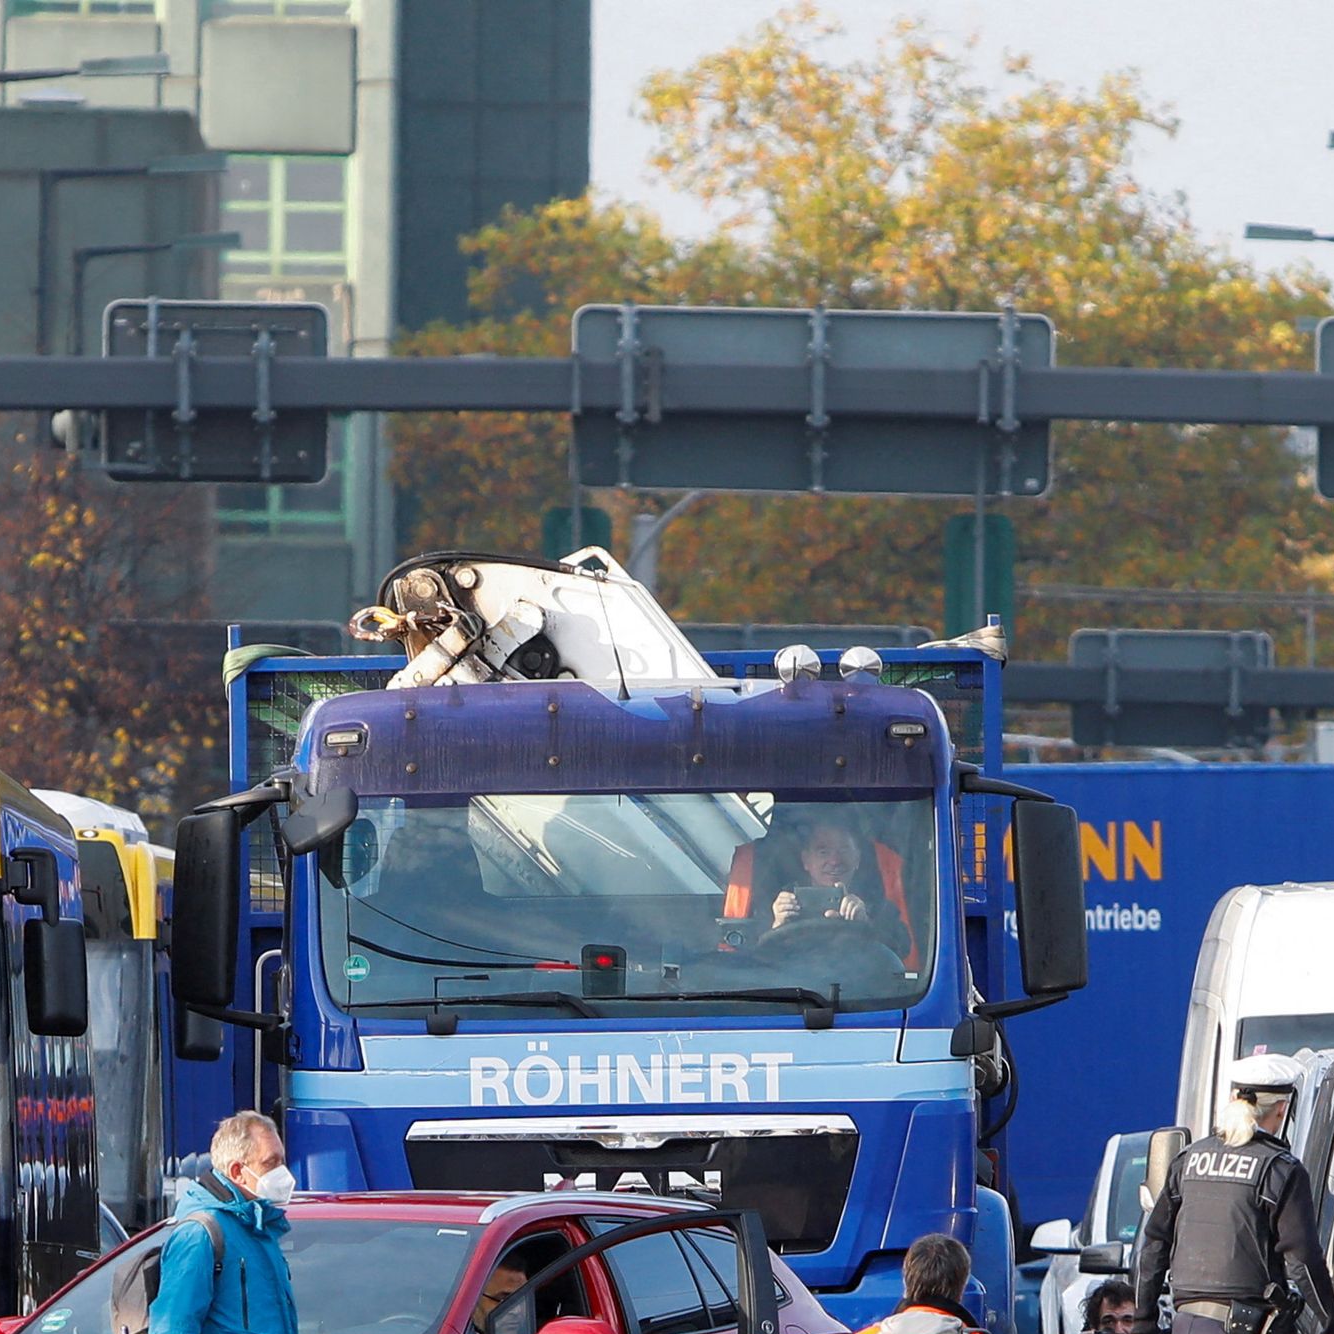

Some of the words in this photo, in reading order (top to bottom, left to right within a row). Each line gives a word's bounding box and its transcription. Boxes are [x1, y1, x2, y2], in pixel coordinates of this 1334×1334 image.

[1084, 903, 1162, 932] ntriebe
[469, 1041, 794, 1107] RÖHNERT
[1185, 1151, 1259, 1180] POLIZEI
